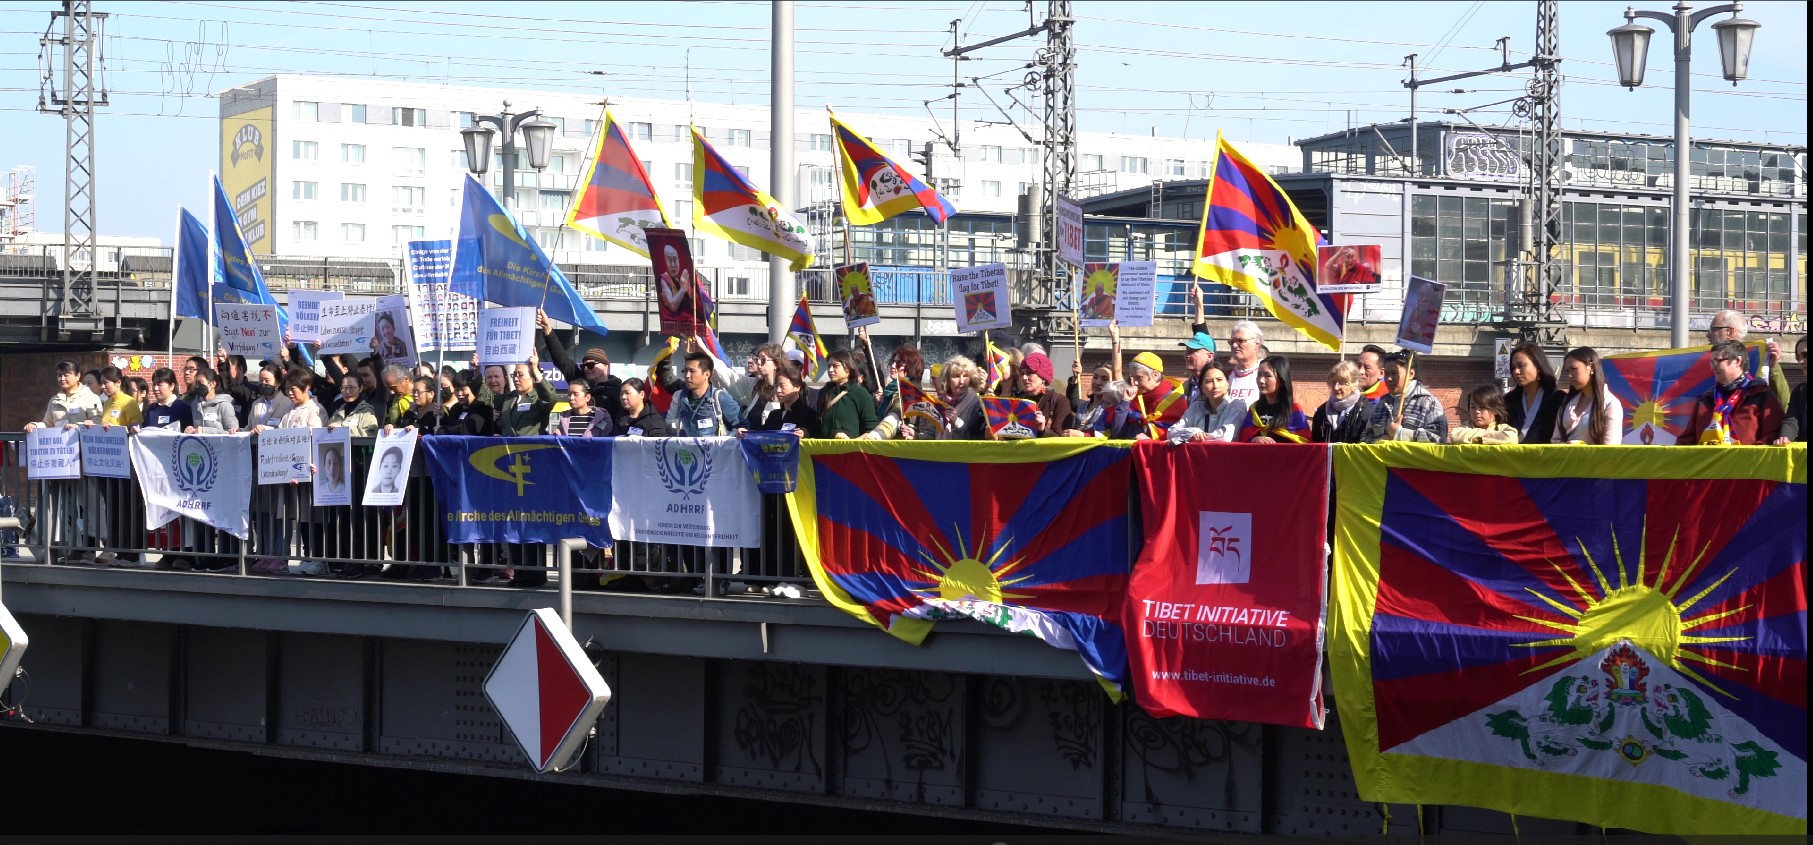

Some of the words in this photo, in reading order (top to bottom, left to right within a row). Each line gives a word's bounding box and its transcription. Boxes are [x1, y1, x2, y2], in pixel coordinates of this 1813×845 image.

[235, 125, 260, 150] KLUB
[240, 149, 254, 161] McFIT
[236, 189, 250, 210] DEIN
[251, 180, 266, 201] KIEZ
[243, 206, 257, 226] GYM
[247, 223, 264, 244] KLUB
[1064, 222, 1081, 251] TIBET
[477, 265, 491, 274] des
[507, 261, 520, 272] Die
[952, 274, 968, 283] Raise
[969, 271, 979, 280] the
[980, 268, 1004, 278] Tibetan
[959, 283, 969, 293] flag
[971, 282, 979, 291] for
[980, 279, 999, 289] Tibet!
[490, 317, 519, 328] FREIHEIT
[224, 326, 239, 339] Sagt
[259, 329, 270, 337] zur
[486, 329, 498, 340] FÜR
[500, 330, 520, 340] TIBET!
[57, 446, 75, 455] TÖTEN!
[176, 500, 212, 510] ADHRRF
[667, 503, 705, 514] ADHRRF
[489, 510, 505, 521] des
[506, 510, 575, 525] Allmächtigen
[578, 511, 601, 526] Goes
[1143, 599, 1195, 621] TIBET
[1196, 605, 1291, 628] INITIATIVE
[1143, 619, 1286, 648] DEUTSCHLAND
[1152, 669, 1275, 687] www.tibet-initiative.de
